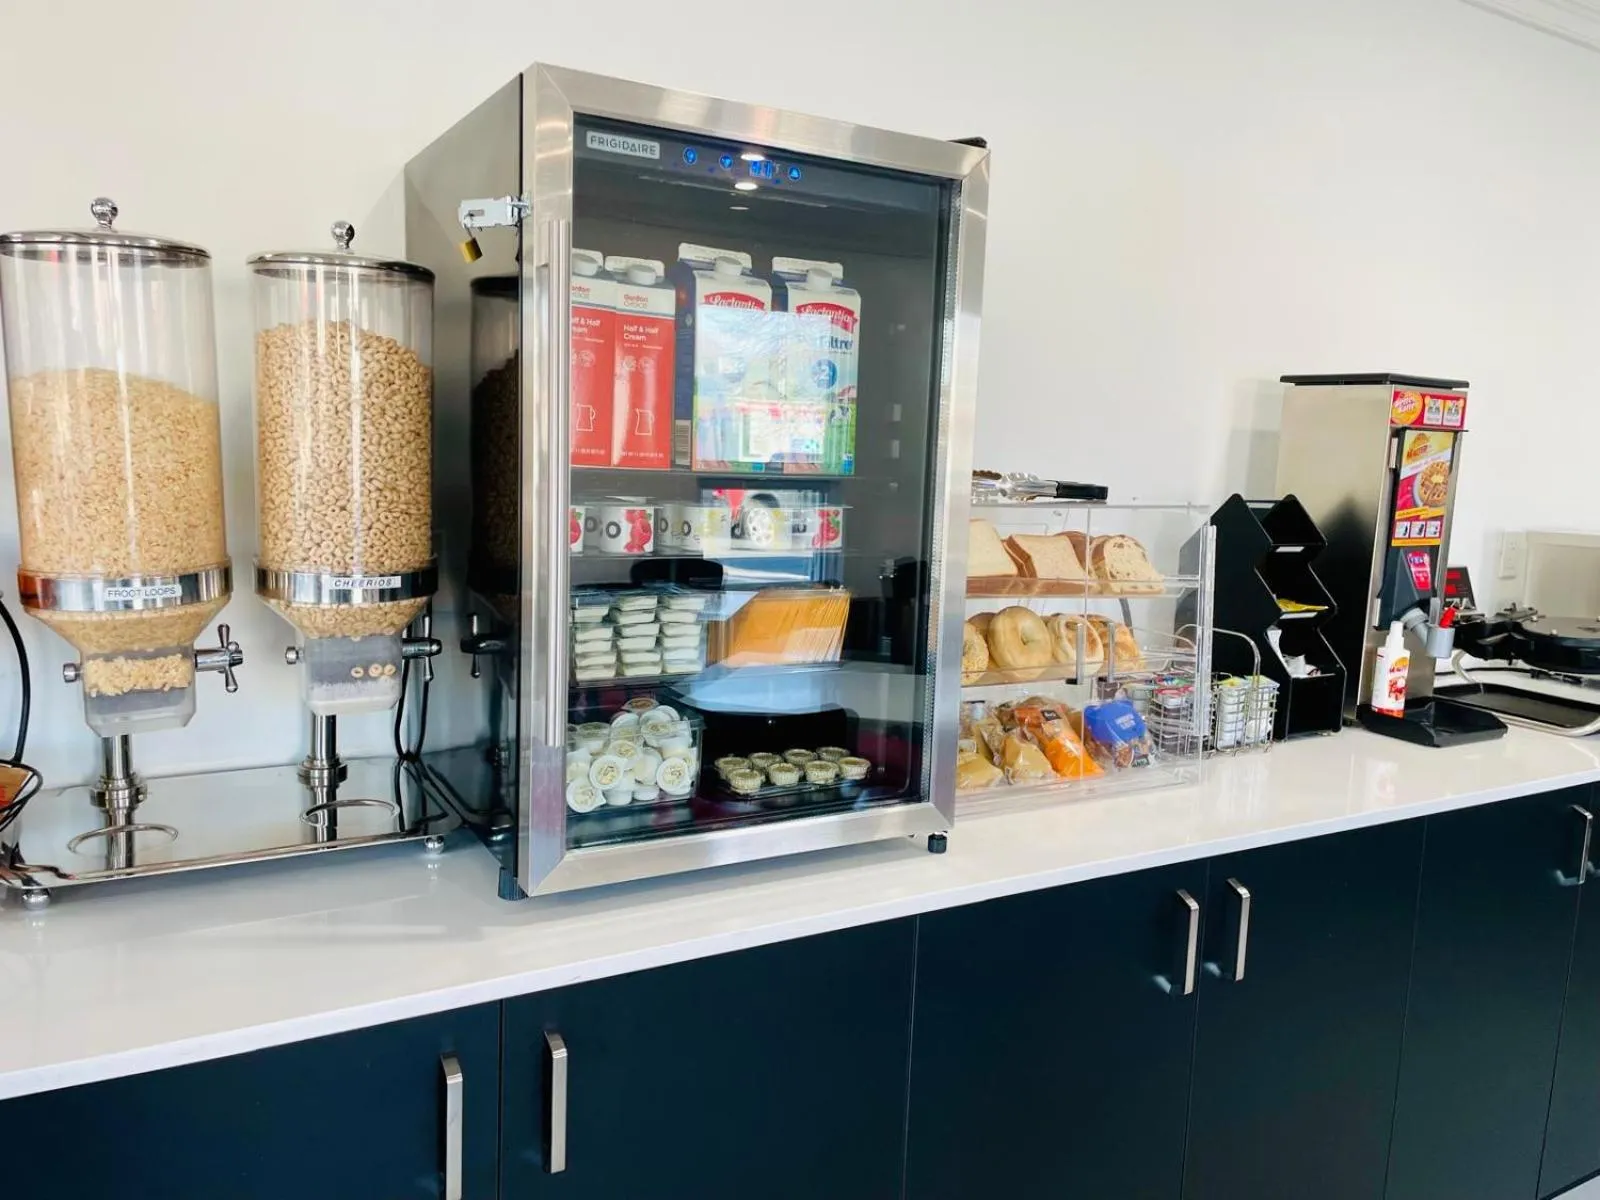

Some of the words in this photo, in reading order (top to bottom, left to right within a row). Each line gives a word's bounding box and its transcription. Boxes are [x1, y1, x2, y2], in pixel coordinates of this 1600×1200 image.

[590, 135, 657, 156] FRIGIDAIRE
[623, 324, 638, 332] Half
[644, 326, 659, 335] Half
[623, 332, 647, 342] Cream
[107, 589, 141, 598] FROOT
[144, 586, 177, 597] LOOPS
